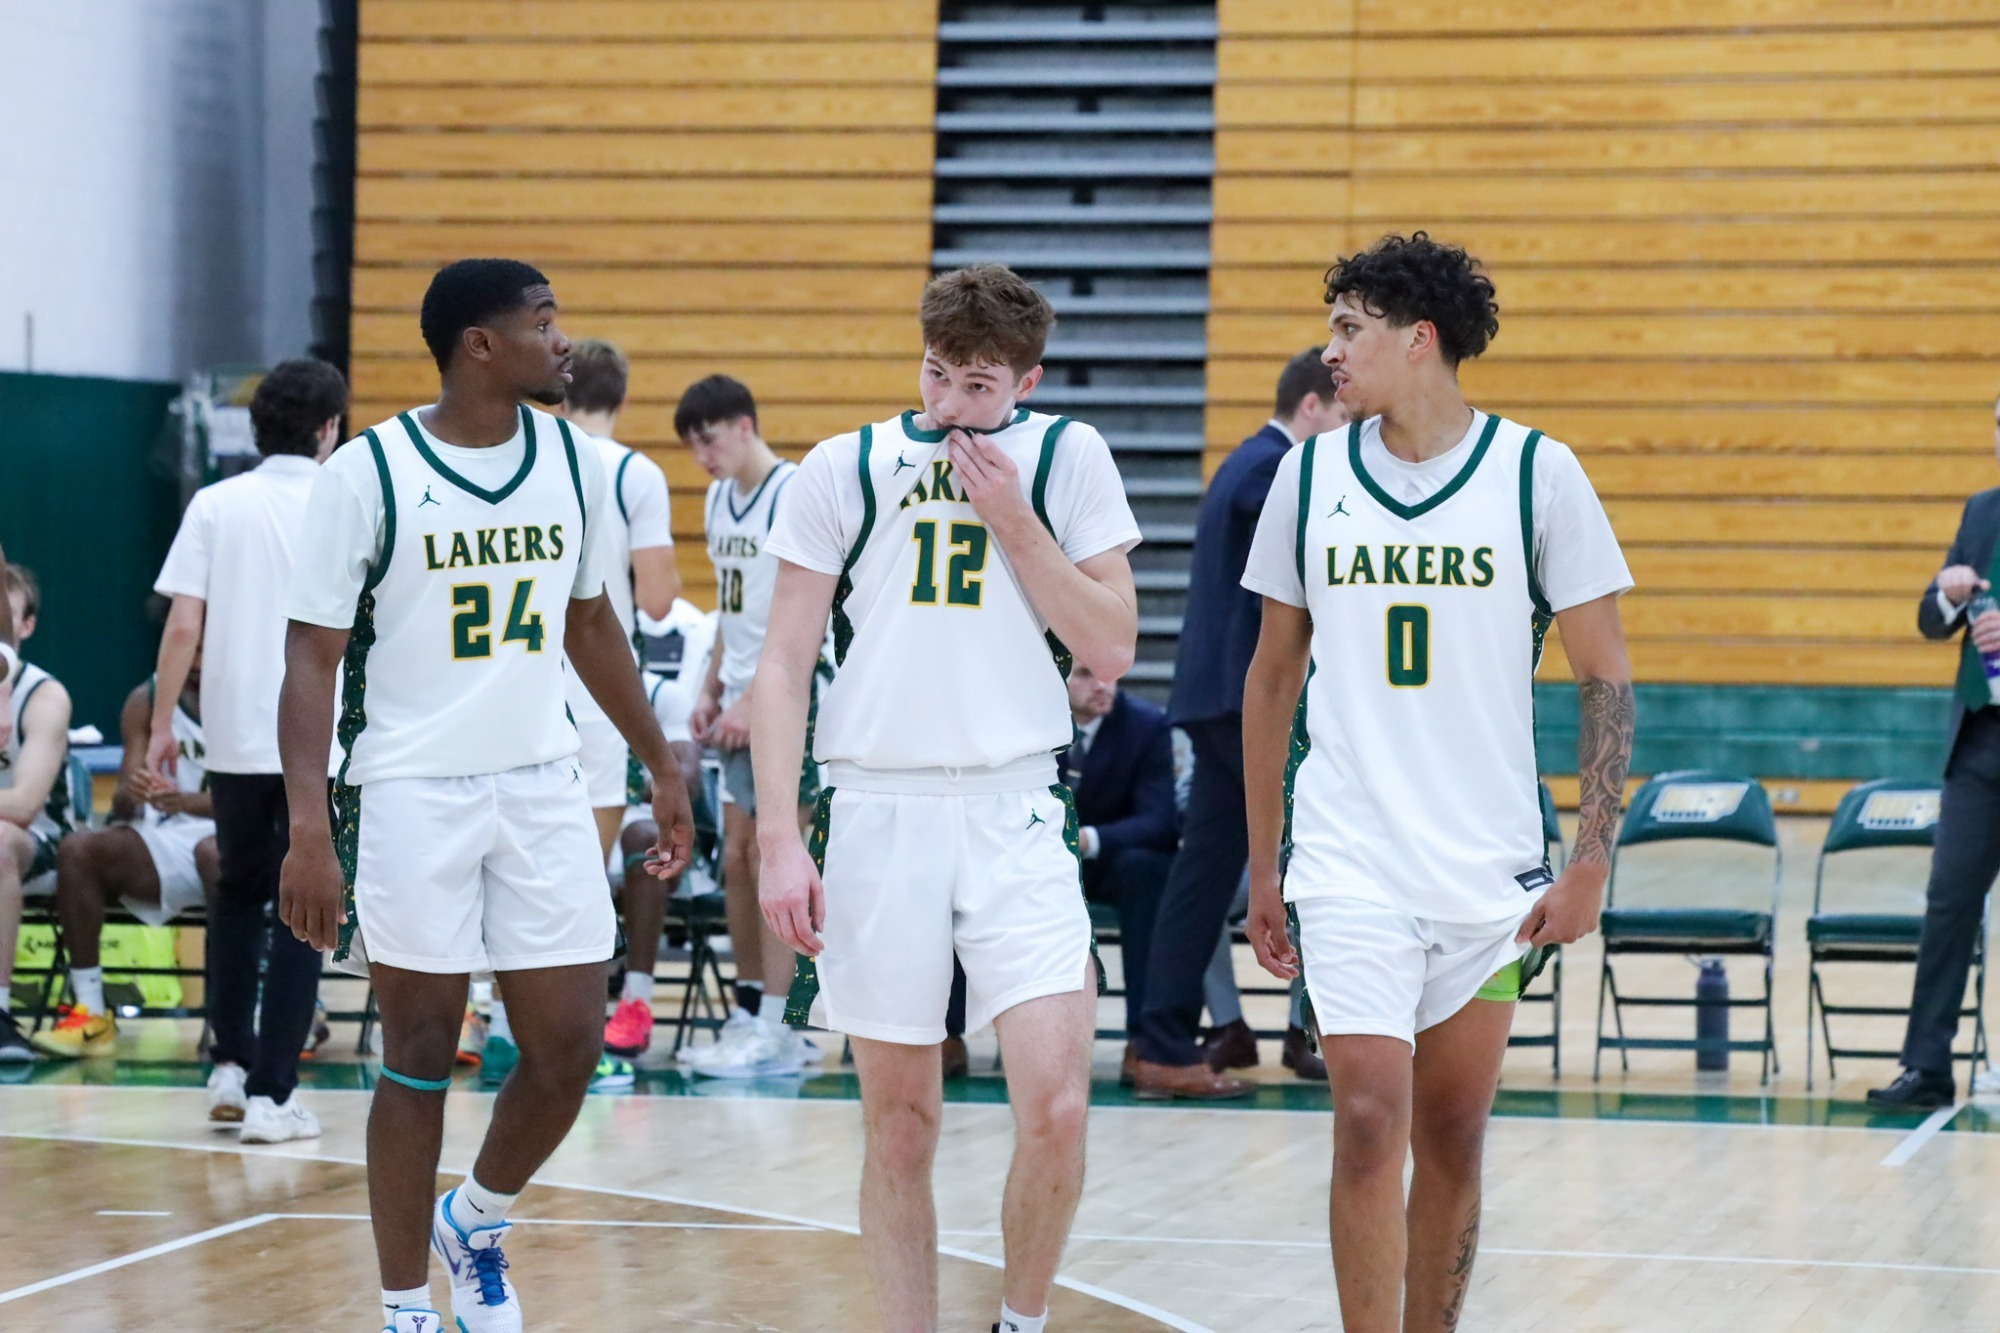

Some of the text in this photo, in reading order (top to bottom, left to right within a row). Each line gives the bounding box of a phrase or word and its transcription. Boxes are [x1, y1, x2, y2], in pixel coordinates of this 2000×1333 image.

[424, 524, 564, 571] LAKERS
[909, 518, 990, 609] 12
[1326, 544, 1495, 588] LAKERS
[451, 577, 546, 661] 24
[721, 567, 744, 613] 10
[1384, 602, 1432, 690] 0
